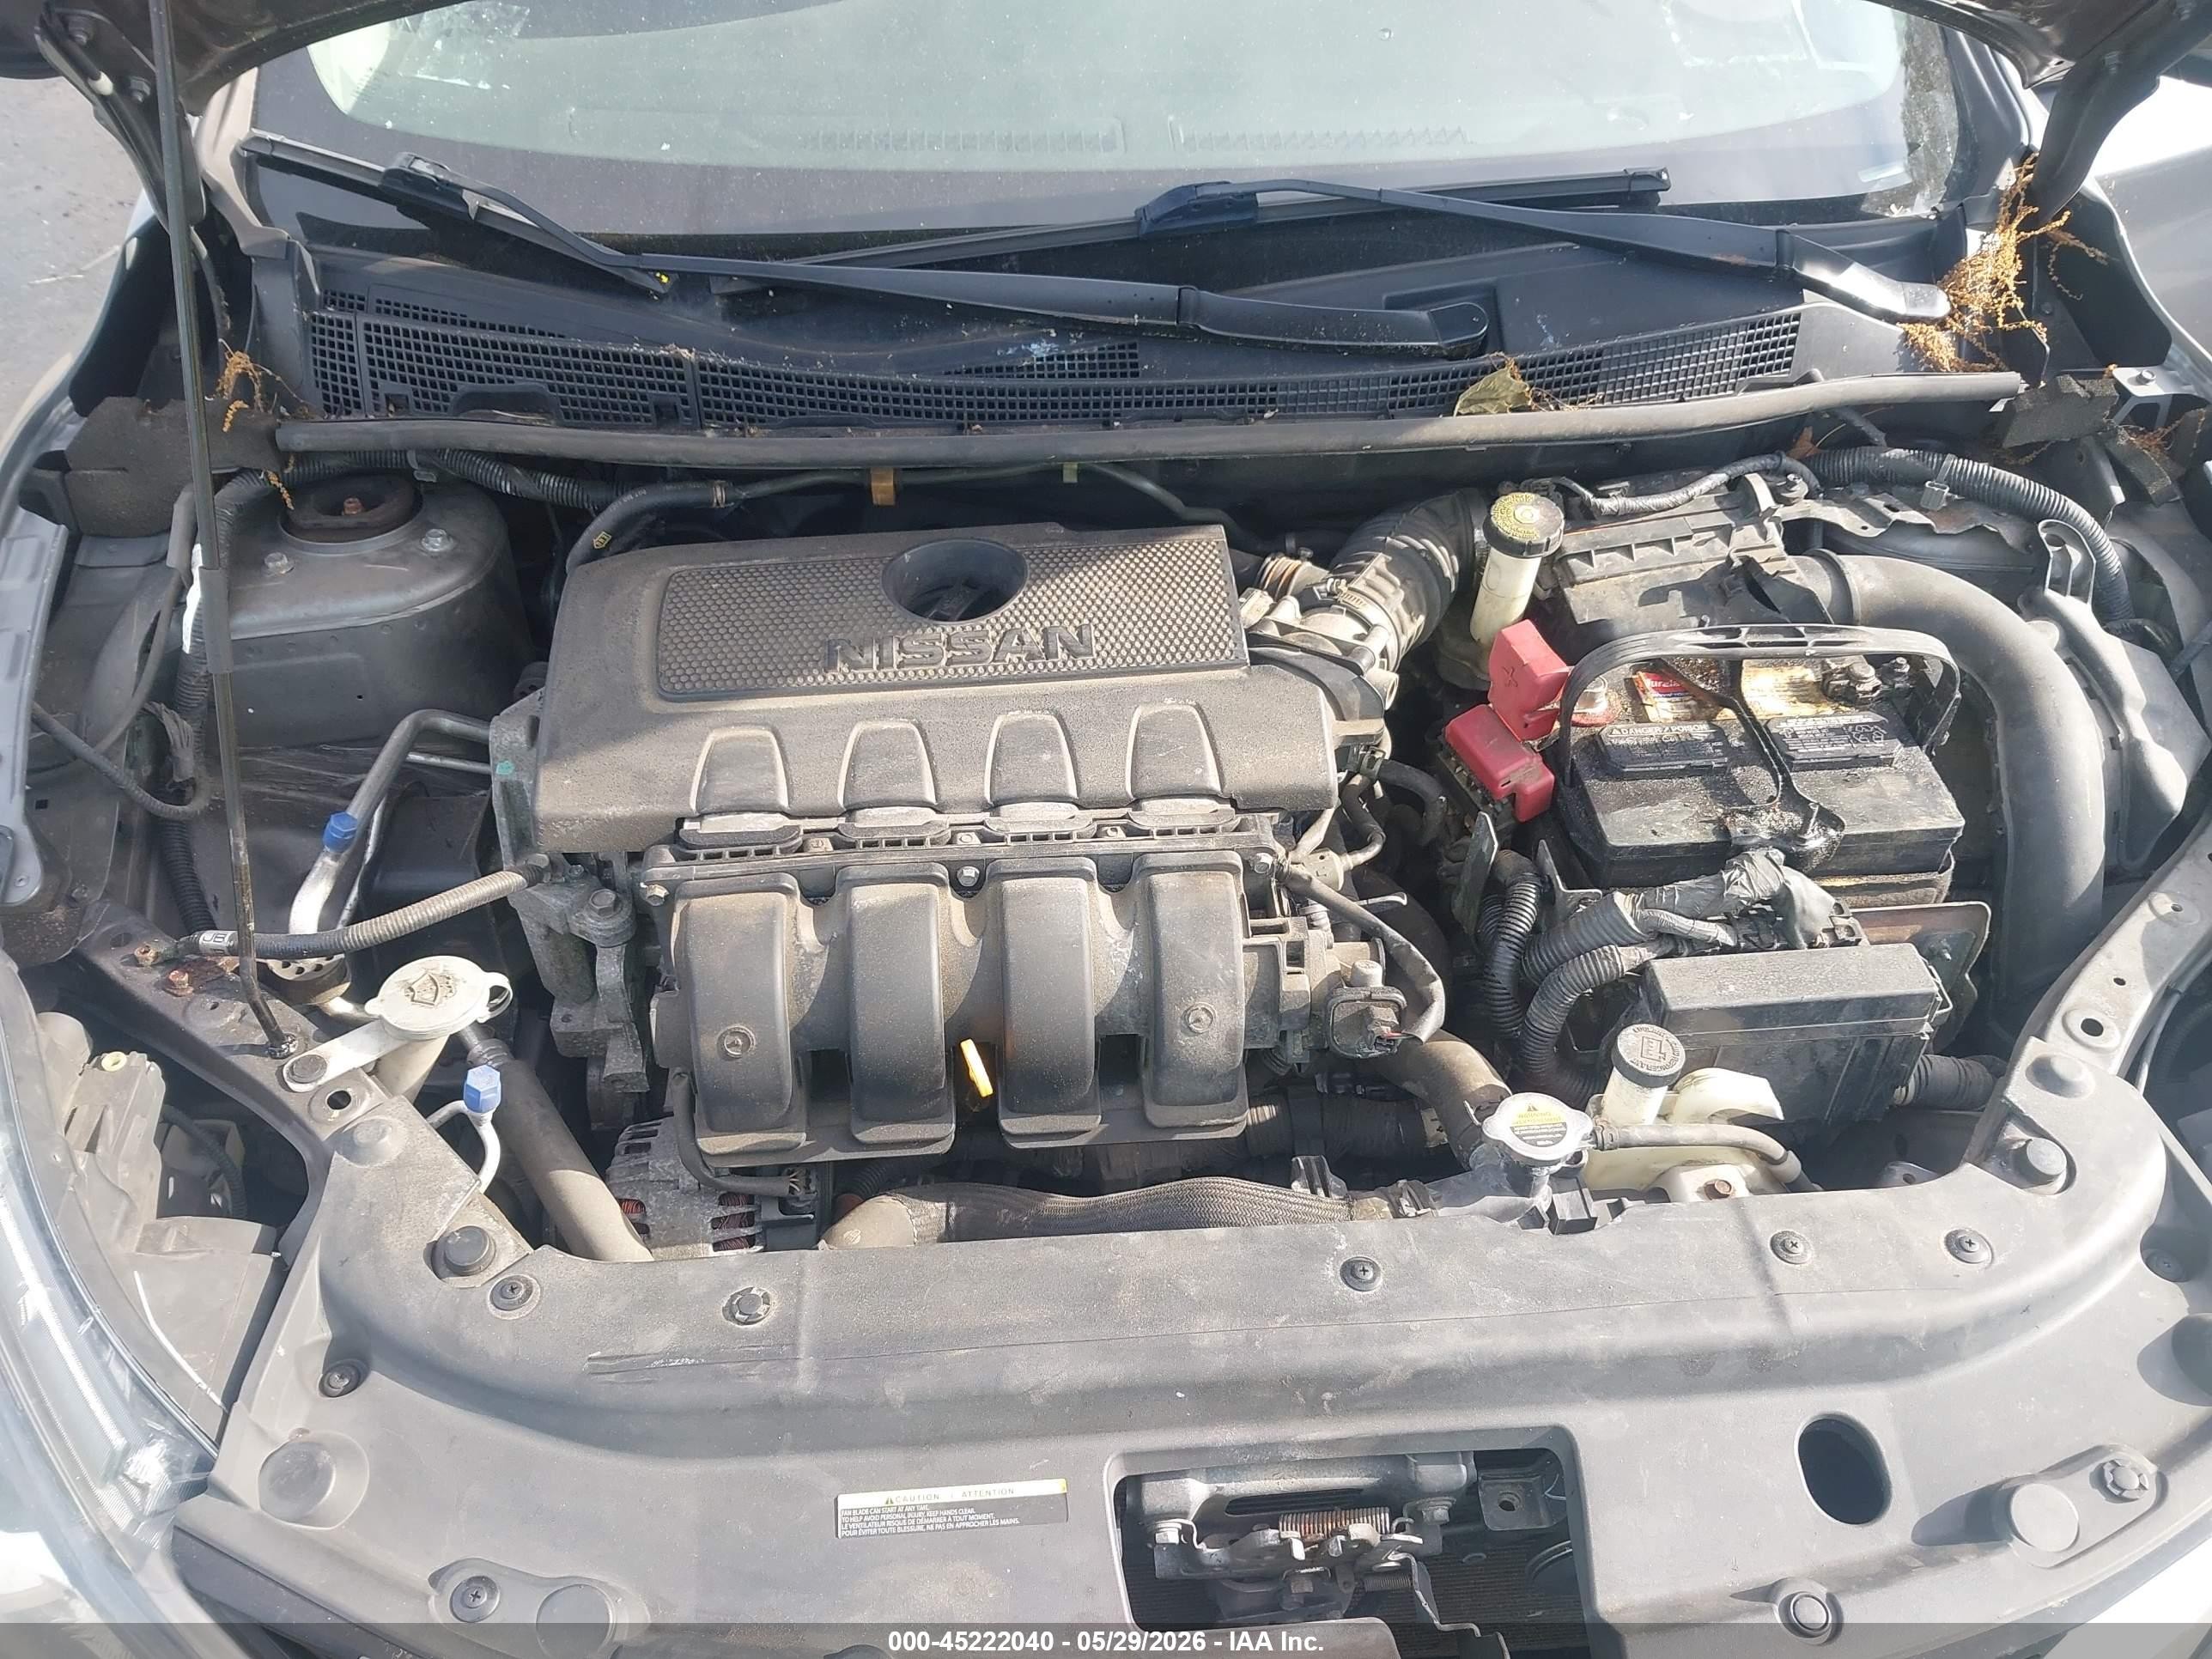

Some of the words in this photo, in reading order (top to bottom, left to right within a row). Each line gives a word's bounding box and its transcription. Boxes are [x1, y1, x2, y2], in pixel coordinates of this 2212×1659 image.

[823, 624, 1095, 673] NISSAN
[1621, 726, 1662, 735] DANGER
[1671, 724, 1708, 732] POISON
[895, 1493, 939, 1504] CAUTION
[961, 1487, 1014, 1498] ATTENTION
